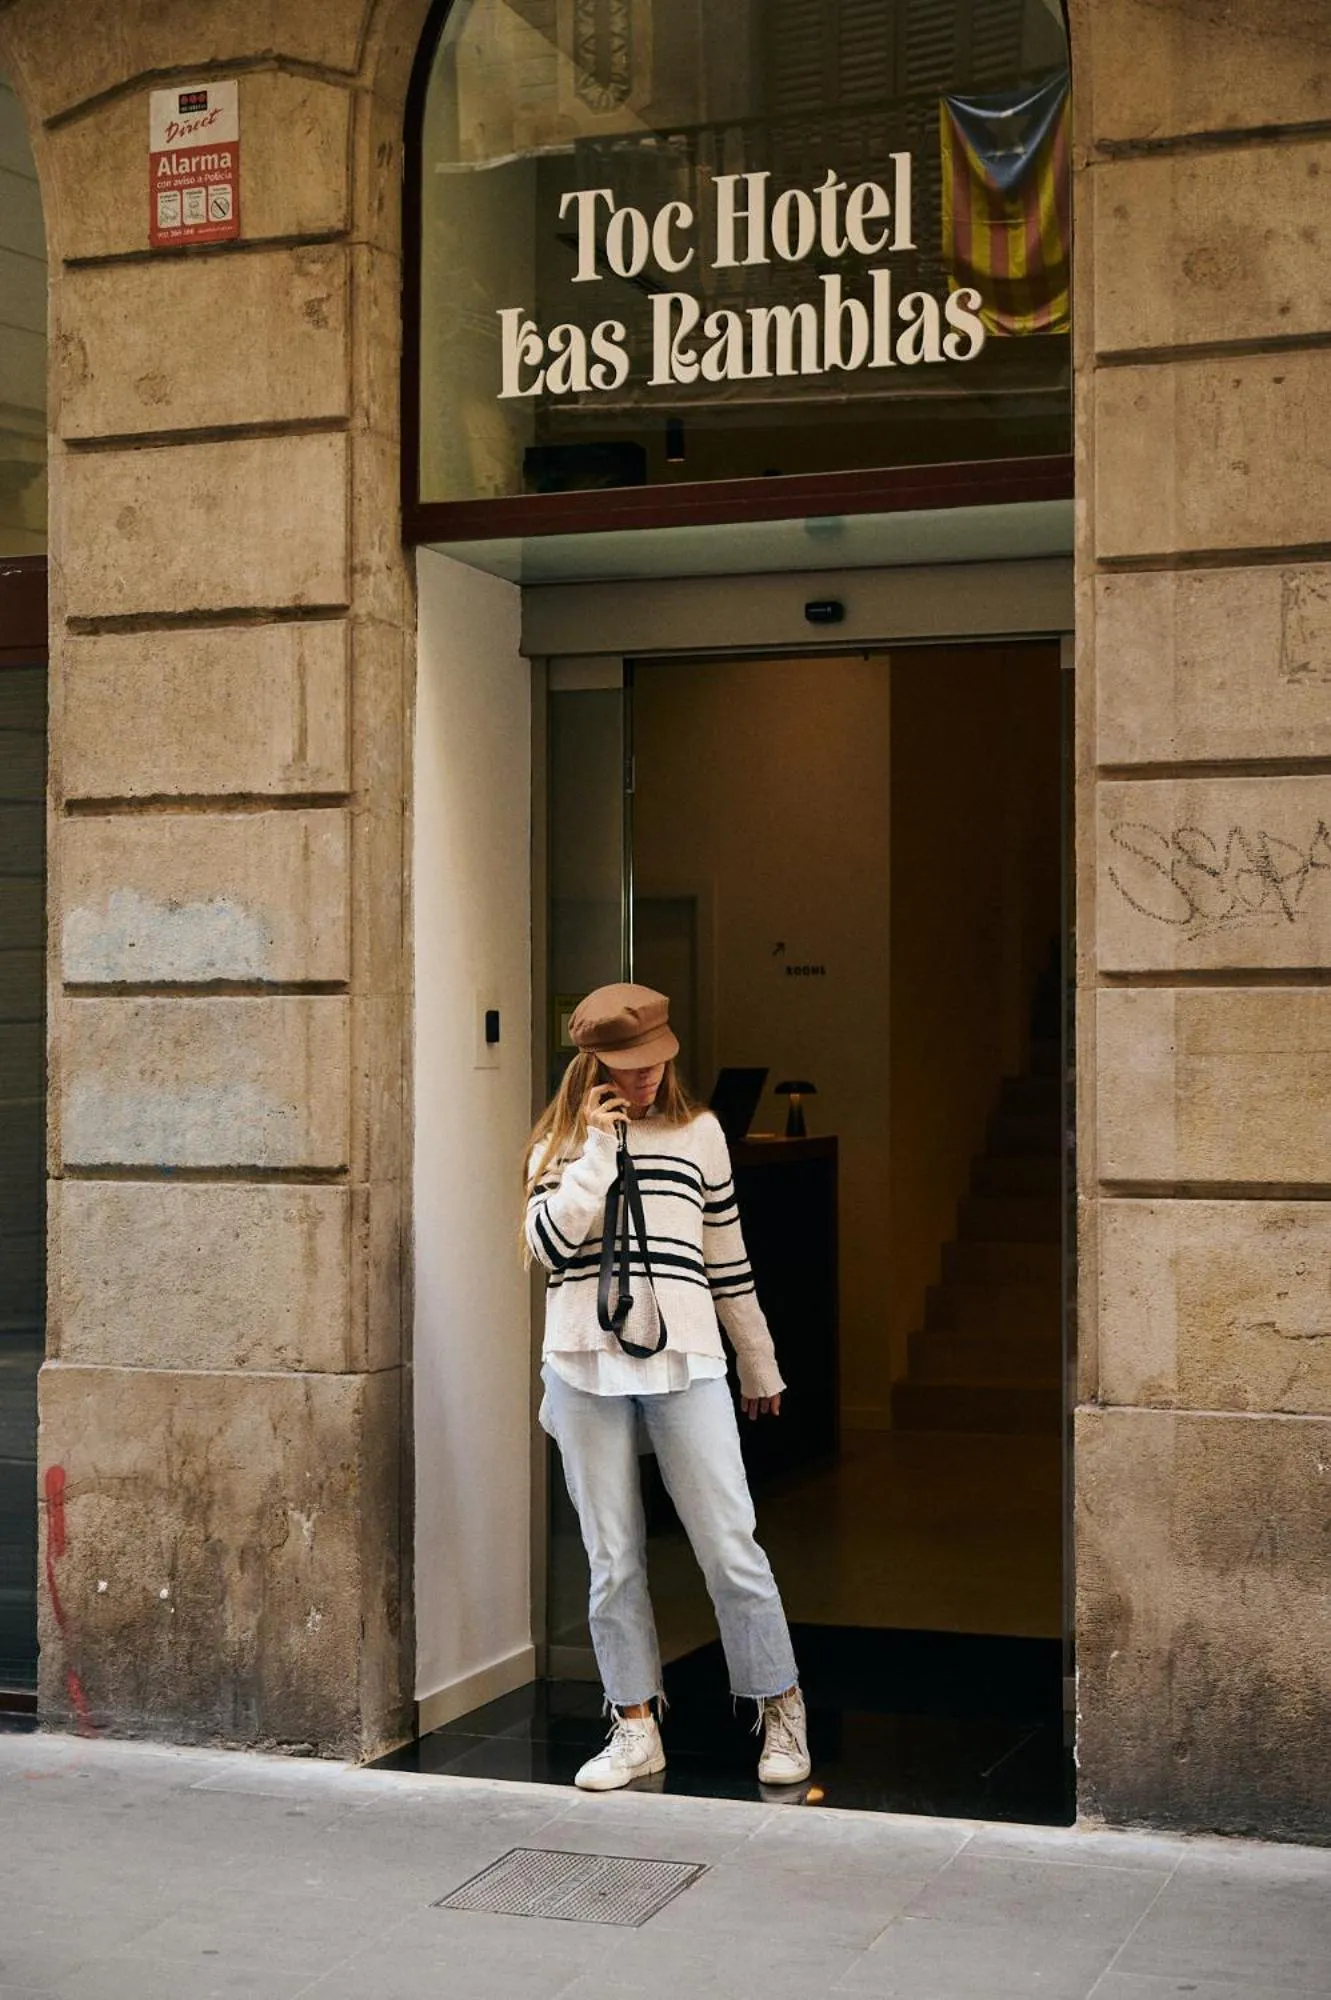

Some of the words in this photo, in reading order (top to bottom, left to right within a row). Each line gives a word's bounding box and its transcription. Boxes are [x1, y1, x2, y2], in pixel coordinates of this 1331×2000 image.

[164, 107, 224, 144] Direct
[156, 179, 171, 189] con
[173, 176, 196, 187] aviso
[157, 152, 232, 177] Alarma
[558, 188, 695, 283] Toc
[711, 151, 917, 269] Hotel
[496, 307, 630, 399] Las
[647, 268, 986, 387] Ramblas
